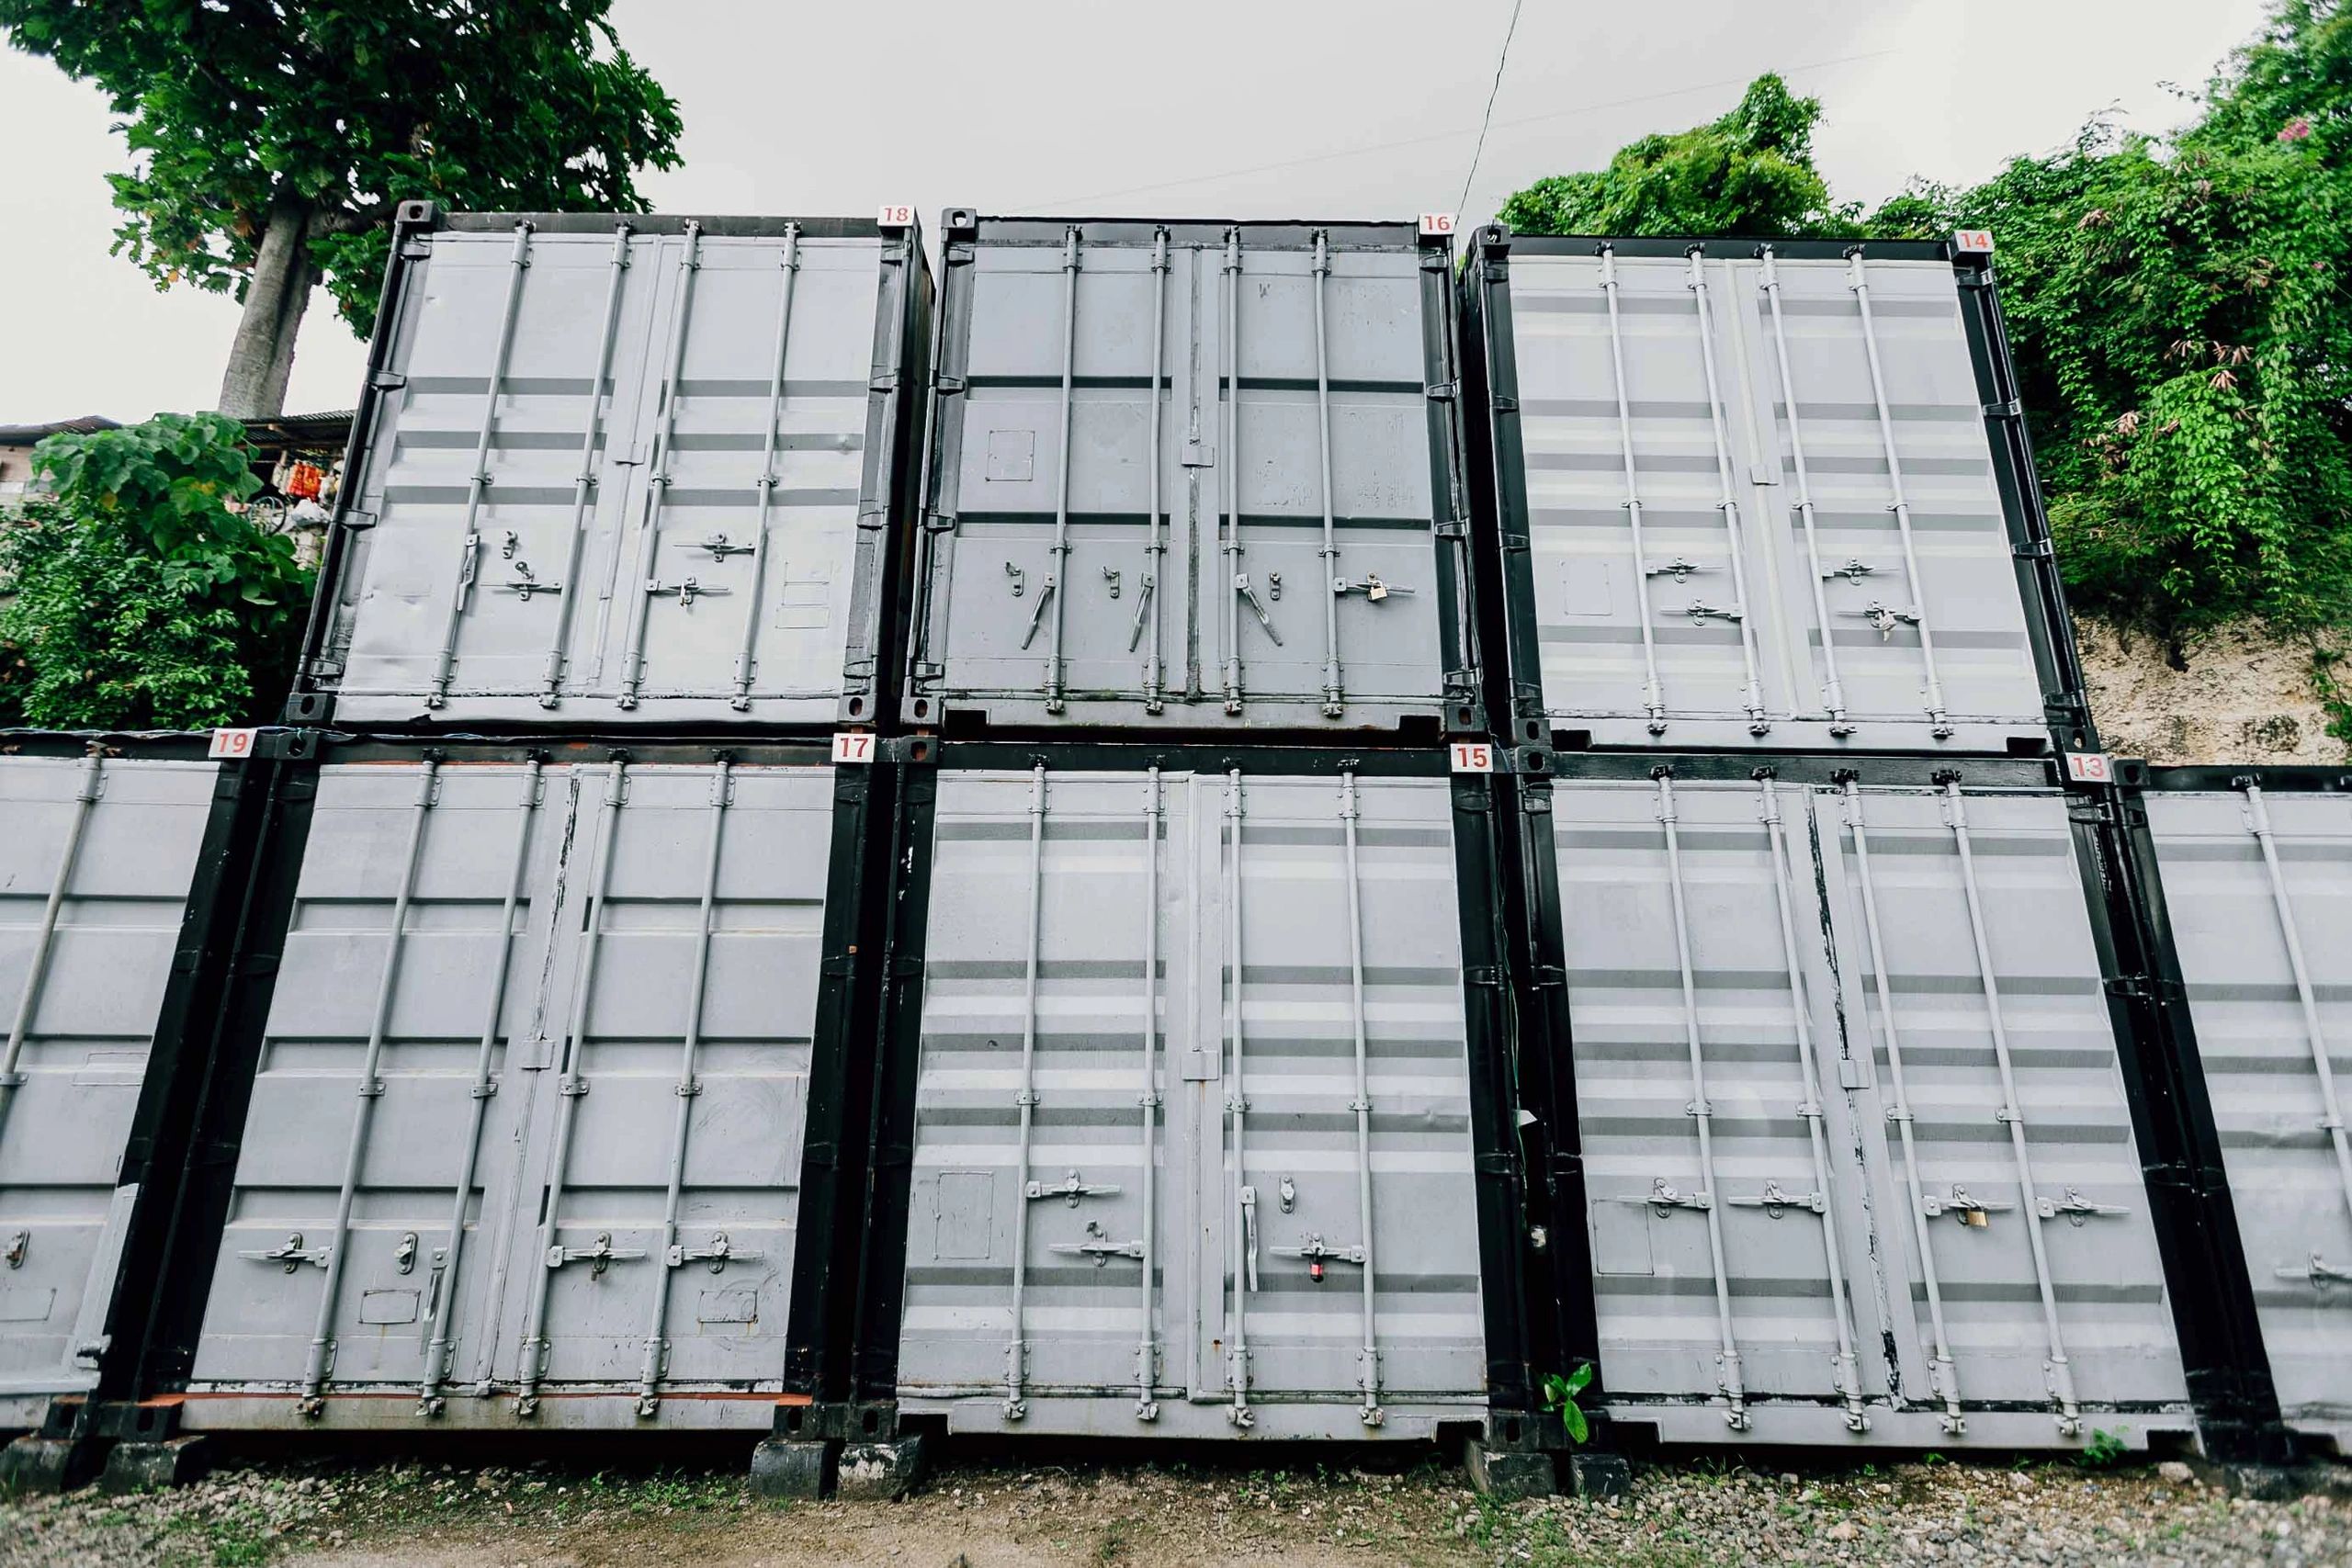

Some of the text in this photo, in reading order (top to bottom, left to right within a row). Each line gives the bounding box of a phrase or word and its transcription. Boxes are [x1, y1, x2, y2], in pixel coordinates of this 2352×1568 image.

[885, 207, 910, 222] 18
[1426, 215, 1451, 231] 16
[1961, 232, 1989, 249] 14
[220, 732, 249, 754] 19
[840, 738, 869, 759] 17
[1457, 747, 1489, 769] 15
[2073, 757, 2105, 779] 13
